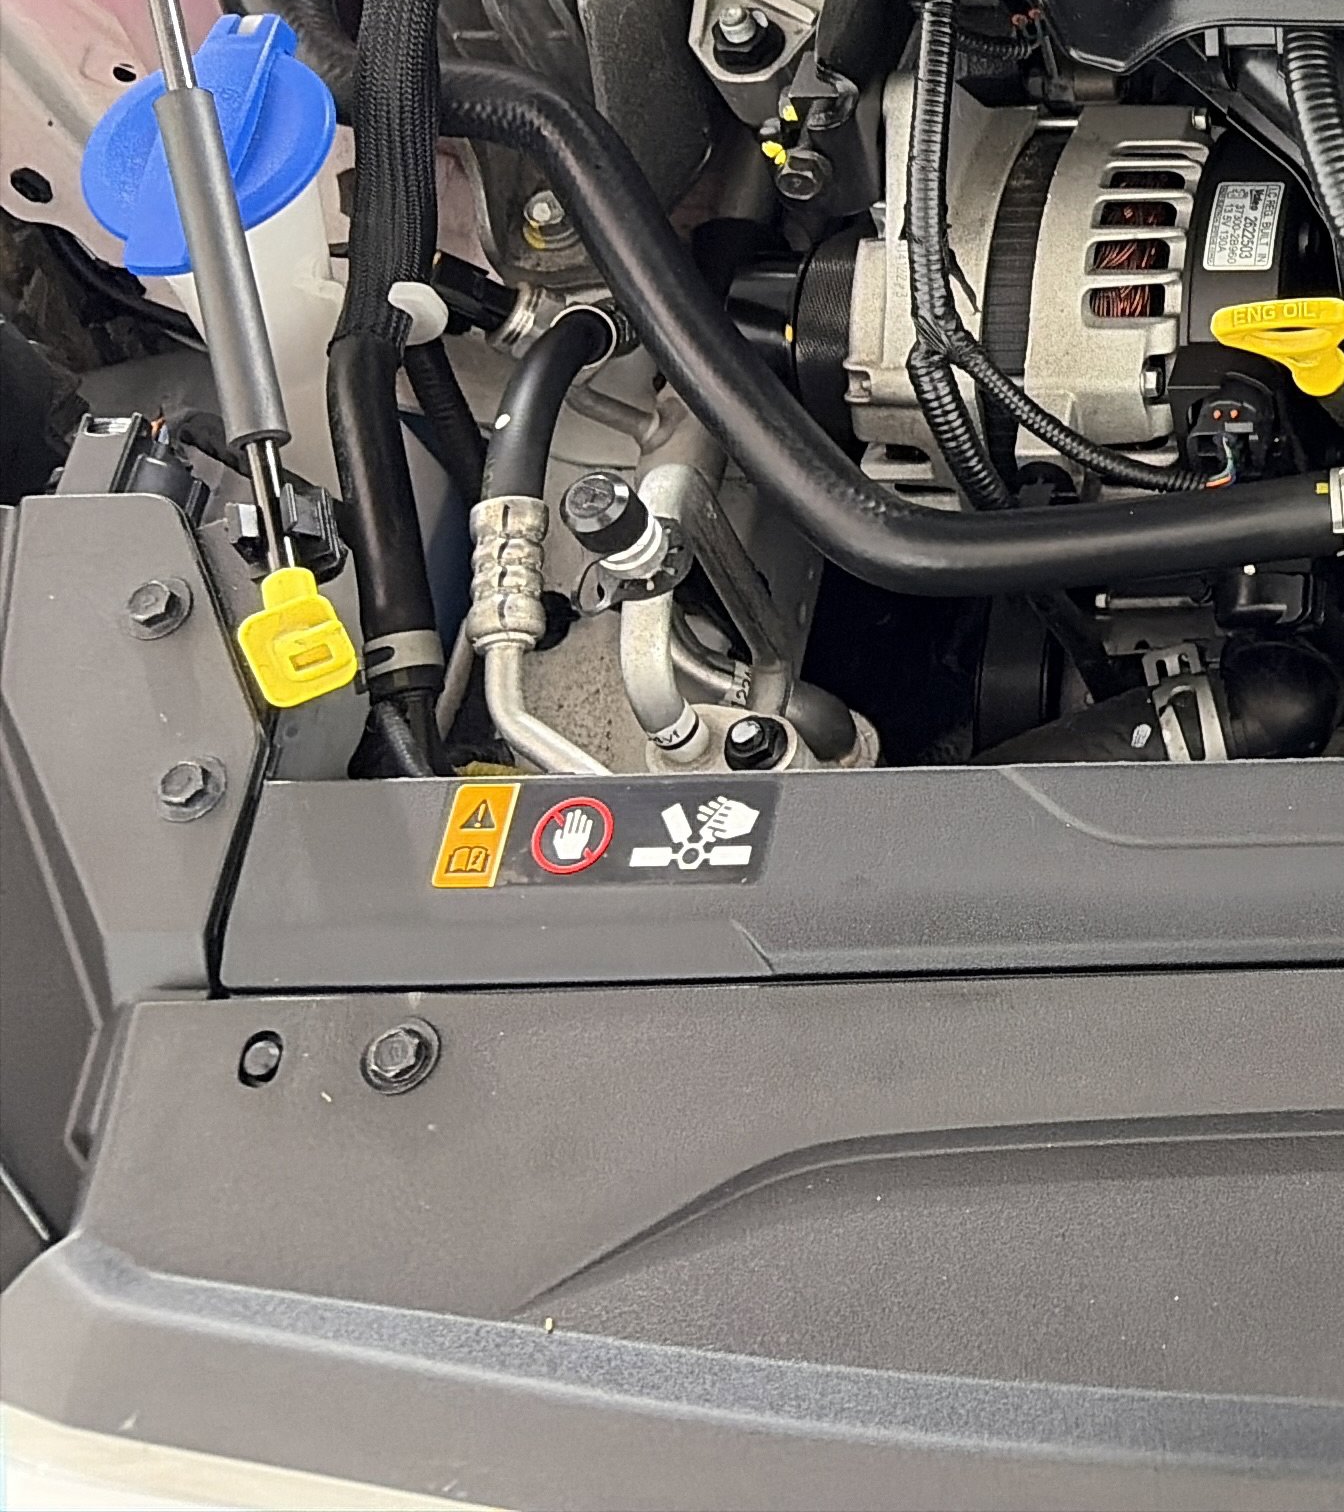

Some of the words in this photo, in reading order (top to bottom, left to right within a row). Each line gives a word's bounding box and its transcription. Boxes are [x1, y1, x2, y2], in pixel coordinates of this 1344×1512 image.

[1239, 215, 1258, 259] 2622503
[1259, 221, 1272, 247] BUILT
[1232, 304, 1276, 327] ENG
[1283, 301, 1316, 319] OIL
